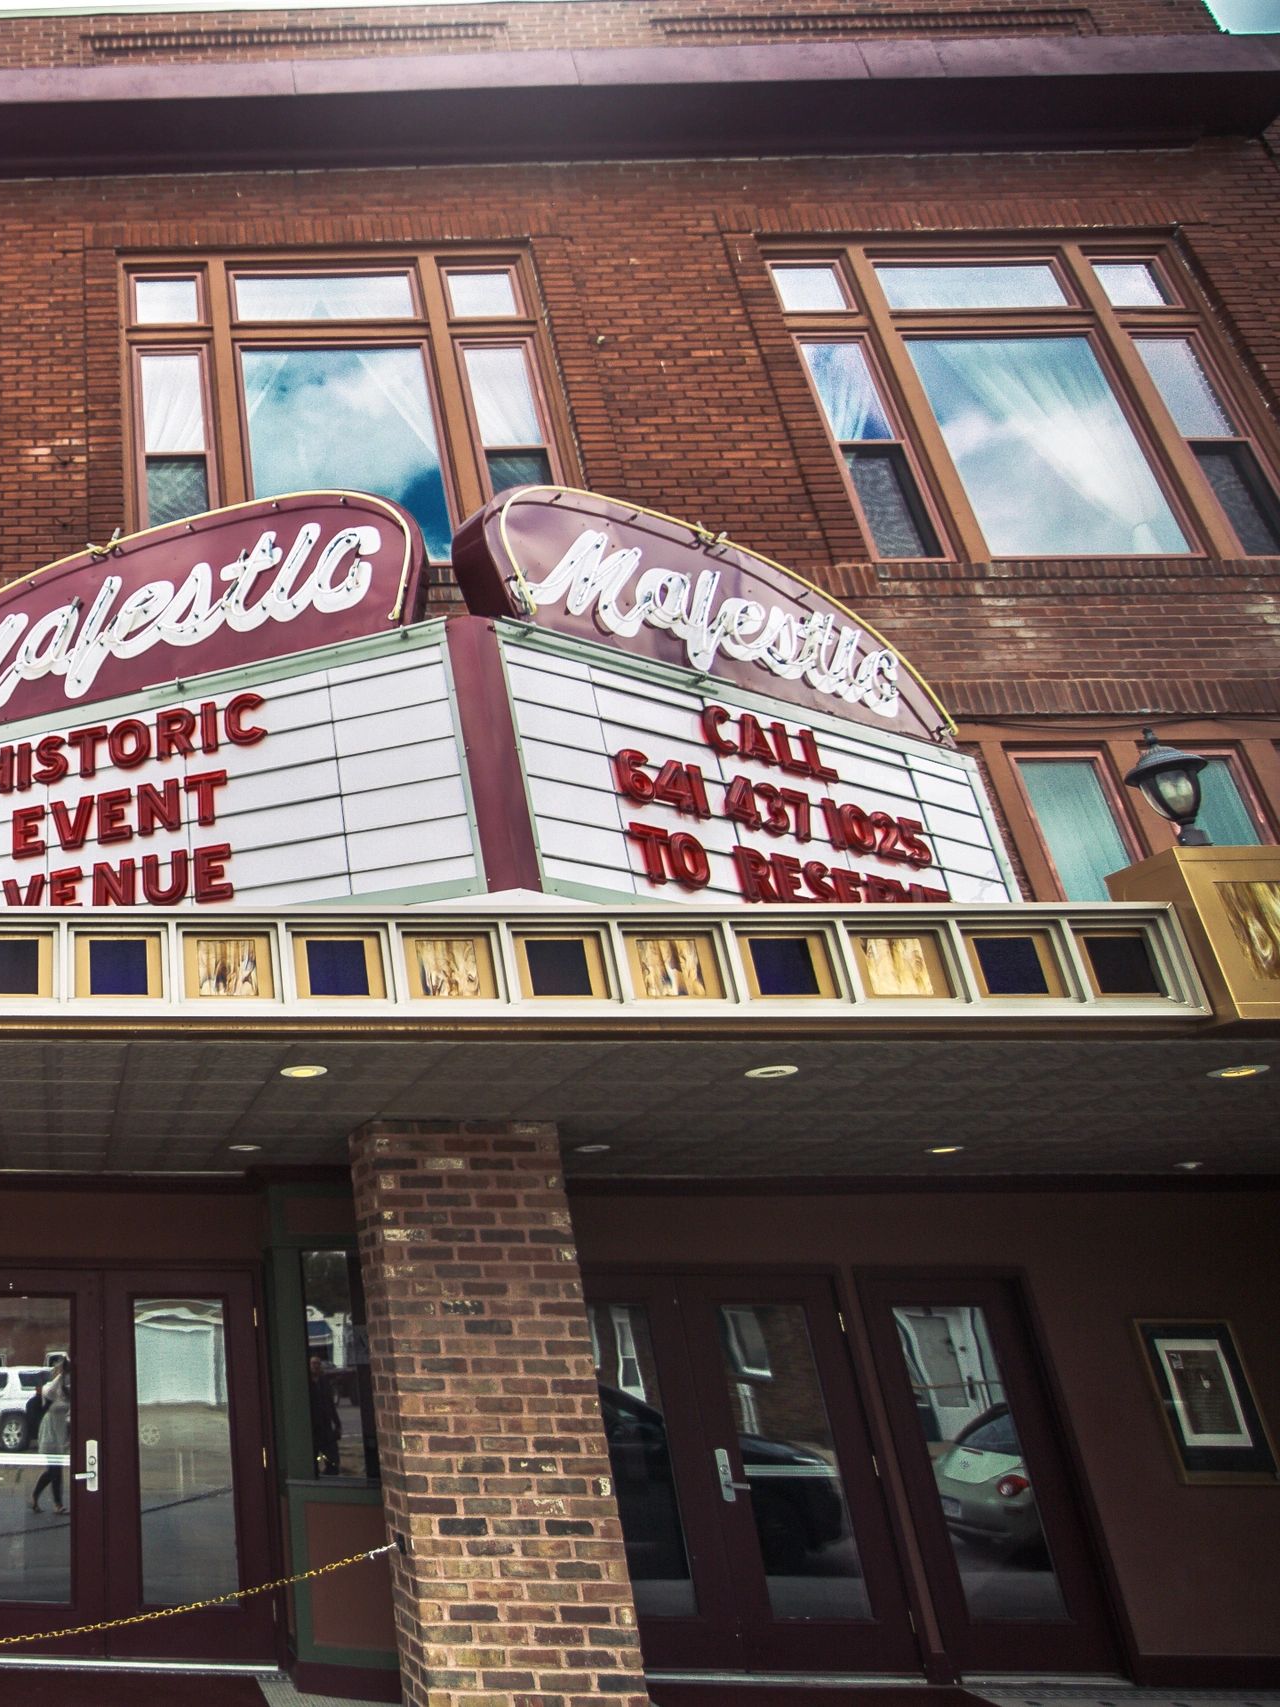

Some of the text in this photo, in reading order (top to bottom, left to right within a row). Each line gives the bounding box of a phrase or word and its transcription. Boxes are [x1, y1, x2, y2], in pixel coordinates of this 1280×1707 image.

[509, 529, 898, 717] Majestic
[702, 705, 839, 783] CALL
[12, 769, 227, 859] EVENT
[615, 749, 932, 868] 641 437 1025
[2, 843, 234, 907] VENUE
[628, 822, 710, 890] TO
